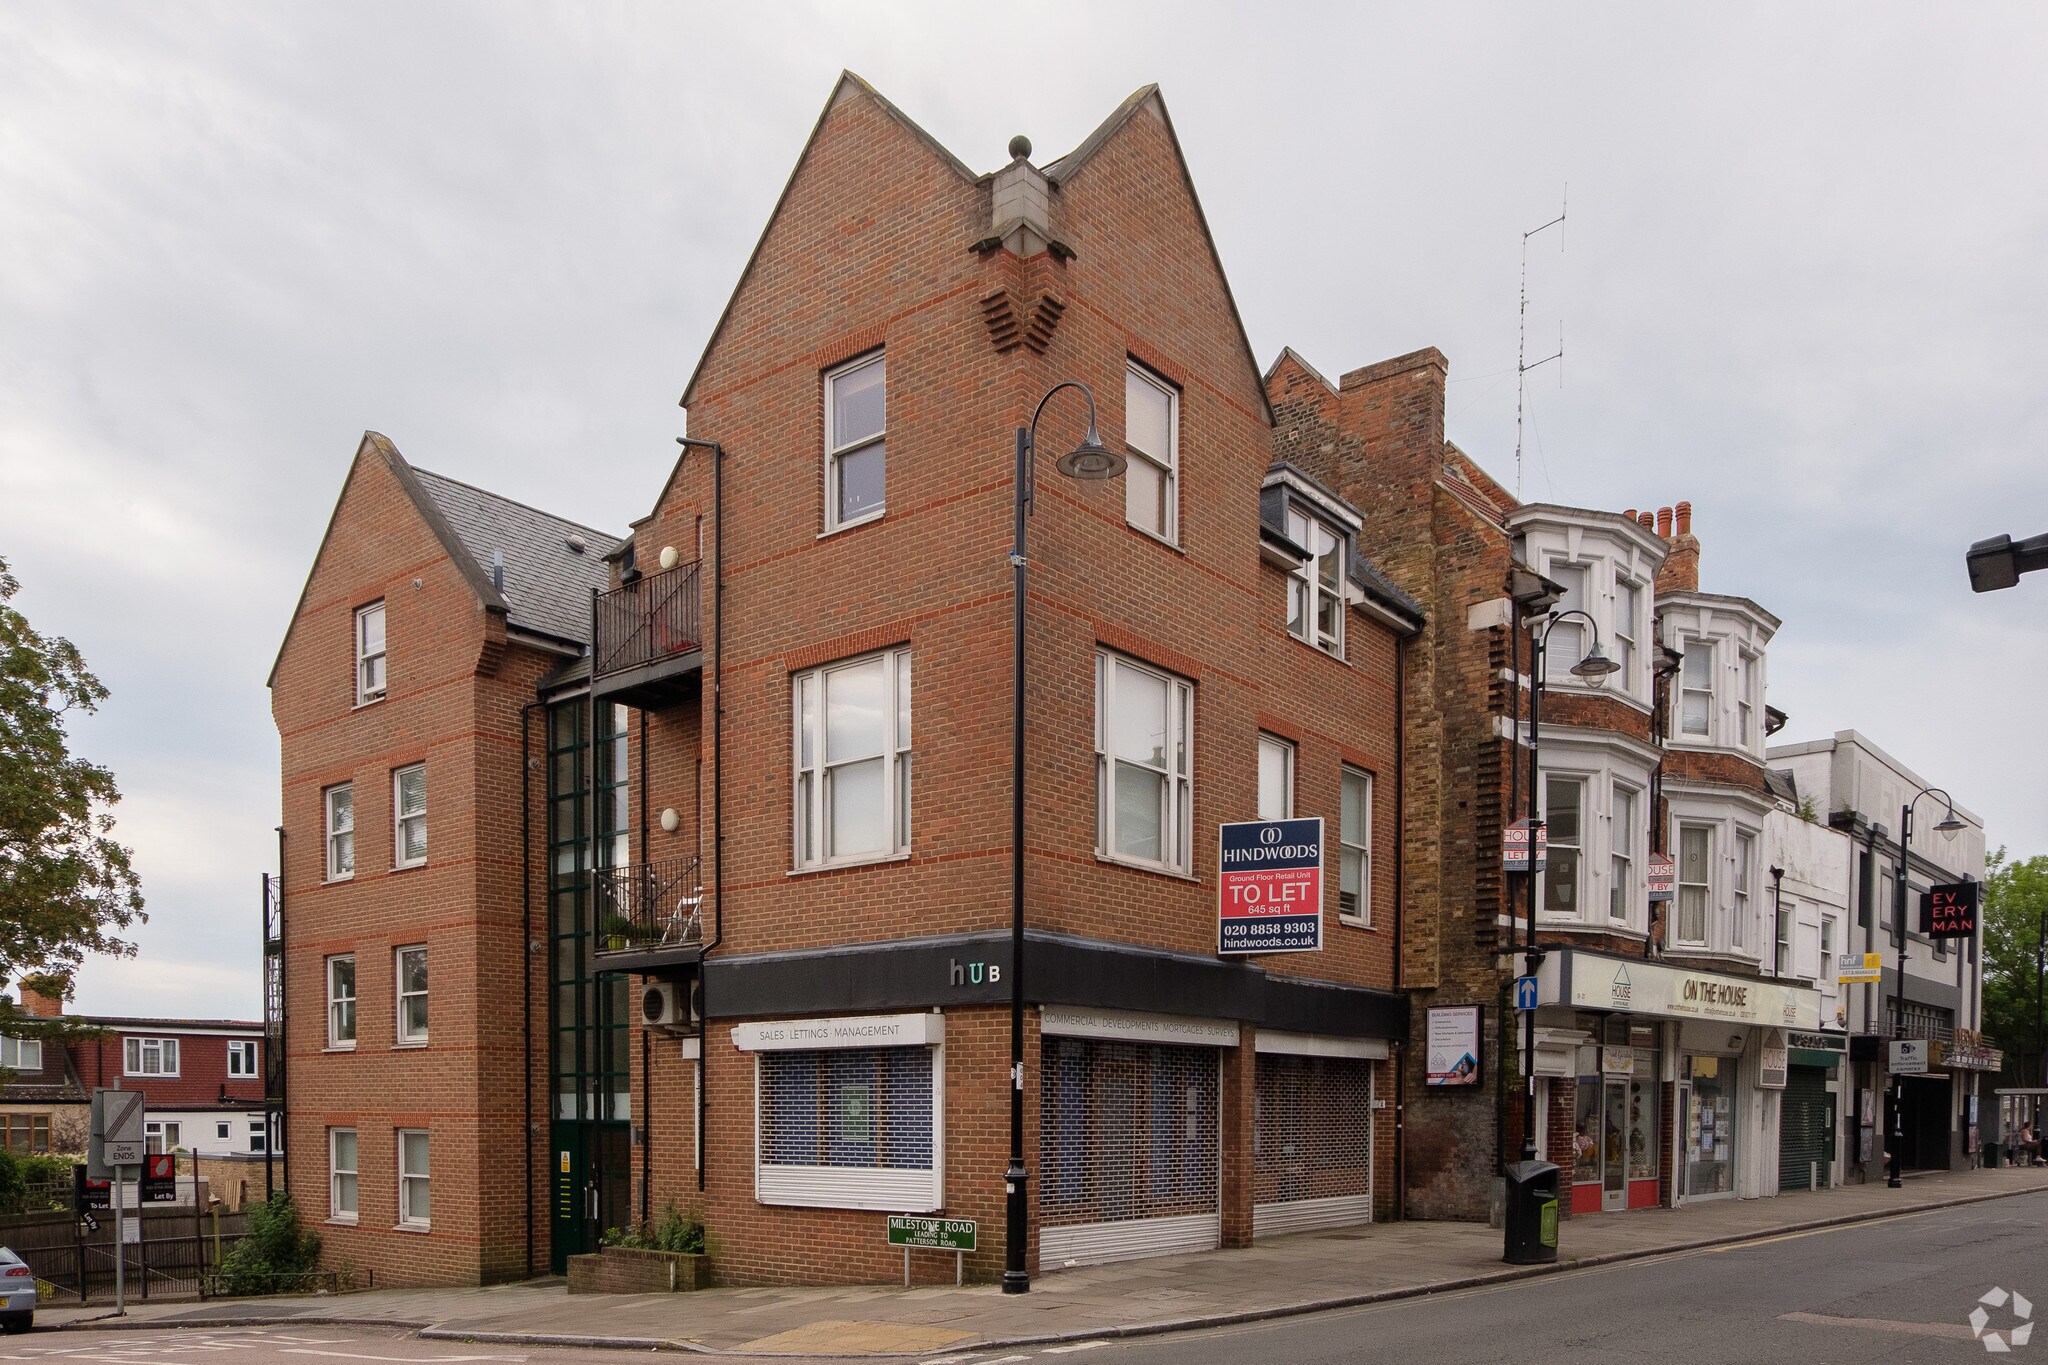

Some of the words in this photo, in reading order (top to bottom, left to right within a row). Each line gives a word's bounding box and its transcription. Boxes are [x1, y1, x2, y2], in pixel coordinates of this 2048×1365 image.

[1880, 776, 1968, 871] EVRYMAN
[1223, 844, 1318, 862] HINDWOODS
[1649, 865, 1673, 875] OUSE
[1229, 884, 1261, 904] TO
[1268, 881, 1311, 903] LET
[1933, 892, 1957, 905] EV
[1248, 905, 1266, 914] 645
[1268, 906, 1281, 914] sq
[1283, 904, 1291, 913] ft
[1932, 905, 1968, 918] ERY
[1224, 925, 1247, 936] 020
[1250, 923, 1281, 935] 8858
[1284, 922, 1315, 934] 9303
[1932, 919, 1974, 932] MAN
[1224, 935, 1314, 948] hindwoods.co.uk
[1840, 956, 1856, 965] hnf
[1611, 985, 1631, 999] HOUSE
[1683, 979, 1698, 1000] ON
[1699, 981, 1716, 1003] THE
[1718, 984, 1748, 1006] HOUSE
[1783, 1007, 1797, 1018] HOUSE
[1044, 1013, 1097, 1027] COMMERCIAL
[1102, 1017, 1159, 1032] DEVELOPMENTS
[1163, 1023, 1204, 1035] MORTGAGES
[1207, 1027, 1235, 1038] SURVEYS
[759, 1030, 785, 1041] SALES
[789, 1028, 829, 1040] LETTINGS
[834, 1024, 900, 1038] MANAGEMENT
[113, 1152, 135, 1160] ENDS
[165, 1192, 174, 1201] By
[890, 1218, 940, 1232] MILESTONE
[945, 1221, 973, 1234] ROAD
[914, 1230, 938, 1239] LEADING
[905, 1237, 938, 1246] PATTERSON
